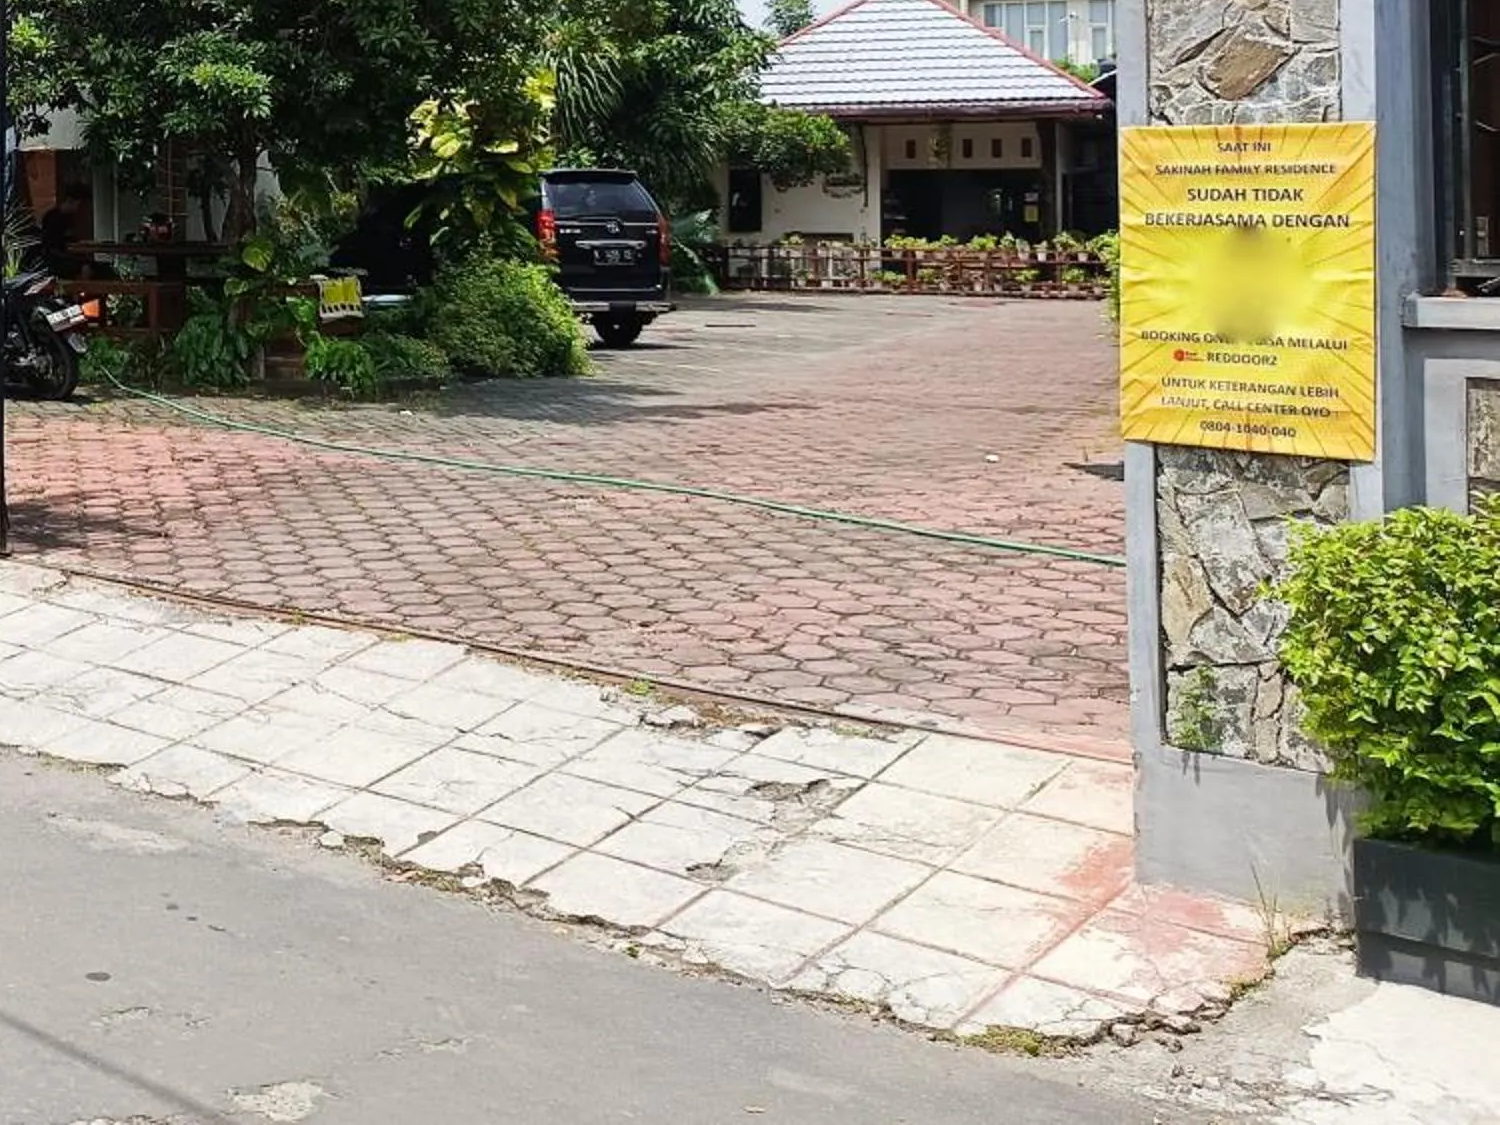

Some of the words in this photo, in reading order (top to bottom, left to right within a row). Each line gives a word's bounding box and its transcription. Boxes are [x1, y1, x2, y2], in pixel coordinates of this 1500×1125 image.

[1217, 142, 1247, 153] SAAT
[1253, 142, 1271, 152] INI
[1155, 164, 1211, 175] SAKINAH
[1215, 164, 1261, 175] FAMILY
[1264, 163, 1336, 174] RESIDENCE
[1187, 188, 1246, 202] SUDAH
[1252, 188, 1304, 202] TIDAK
[1145, 212, 1268, 228] BEKERJASAMA
[1272, 214, 1349, 228] DENGAN
[1141, 330, 1200, 344] BOOKING
[1288, 338, 1348, 350] MELALUI
[1161, 377, 1206, 390] UNTUK
[1209, 379, 1296, 395] KETERANGAN
[1300, 385, 1339, 398] LEBIH
[1213, 398, 1243, 411] CALL
[1247, 402, 1298, 416] CENTER
[1301, 406, 1331, 418] OYO
